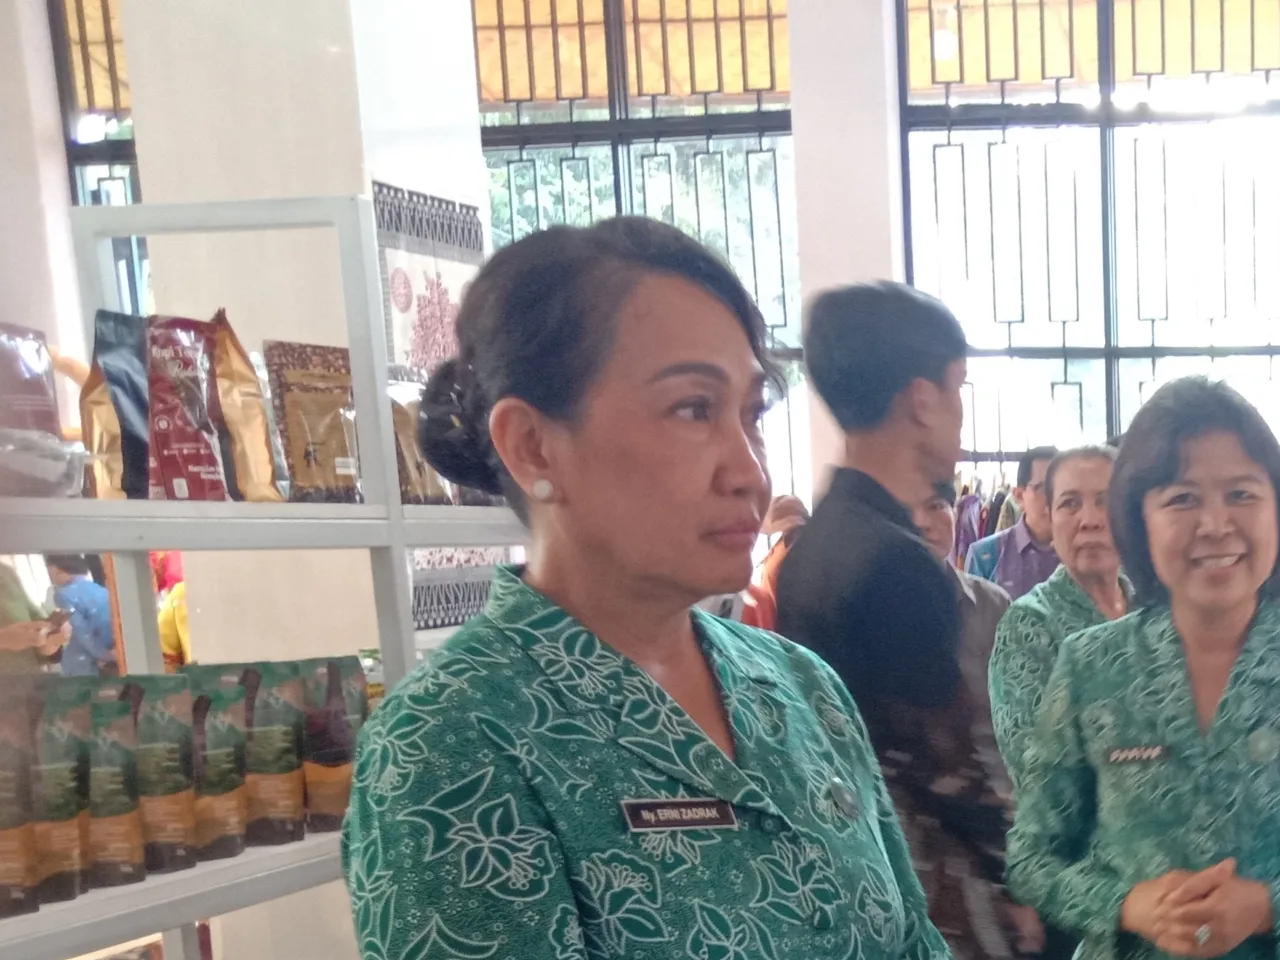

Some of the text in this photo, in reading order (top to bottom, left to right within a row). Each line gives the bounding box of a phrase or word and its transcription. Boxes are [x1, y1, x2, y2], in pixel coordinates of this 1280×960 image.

[640, 807, 720, 824] Ny. ERNI ZADRAK
